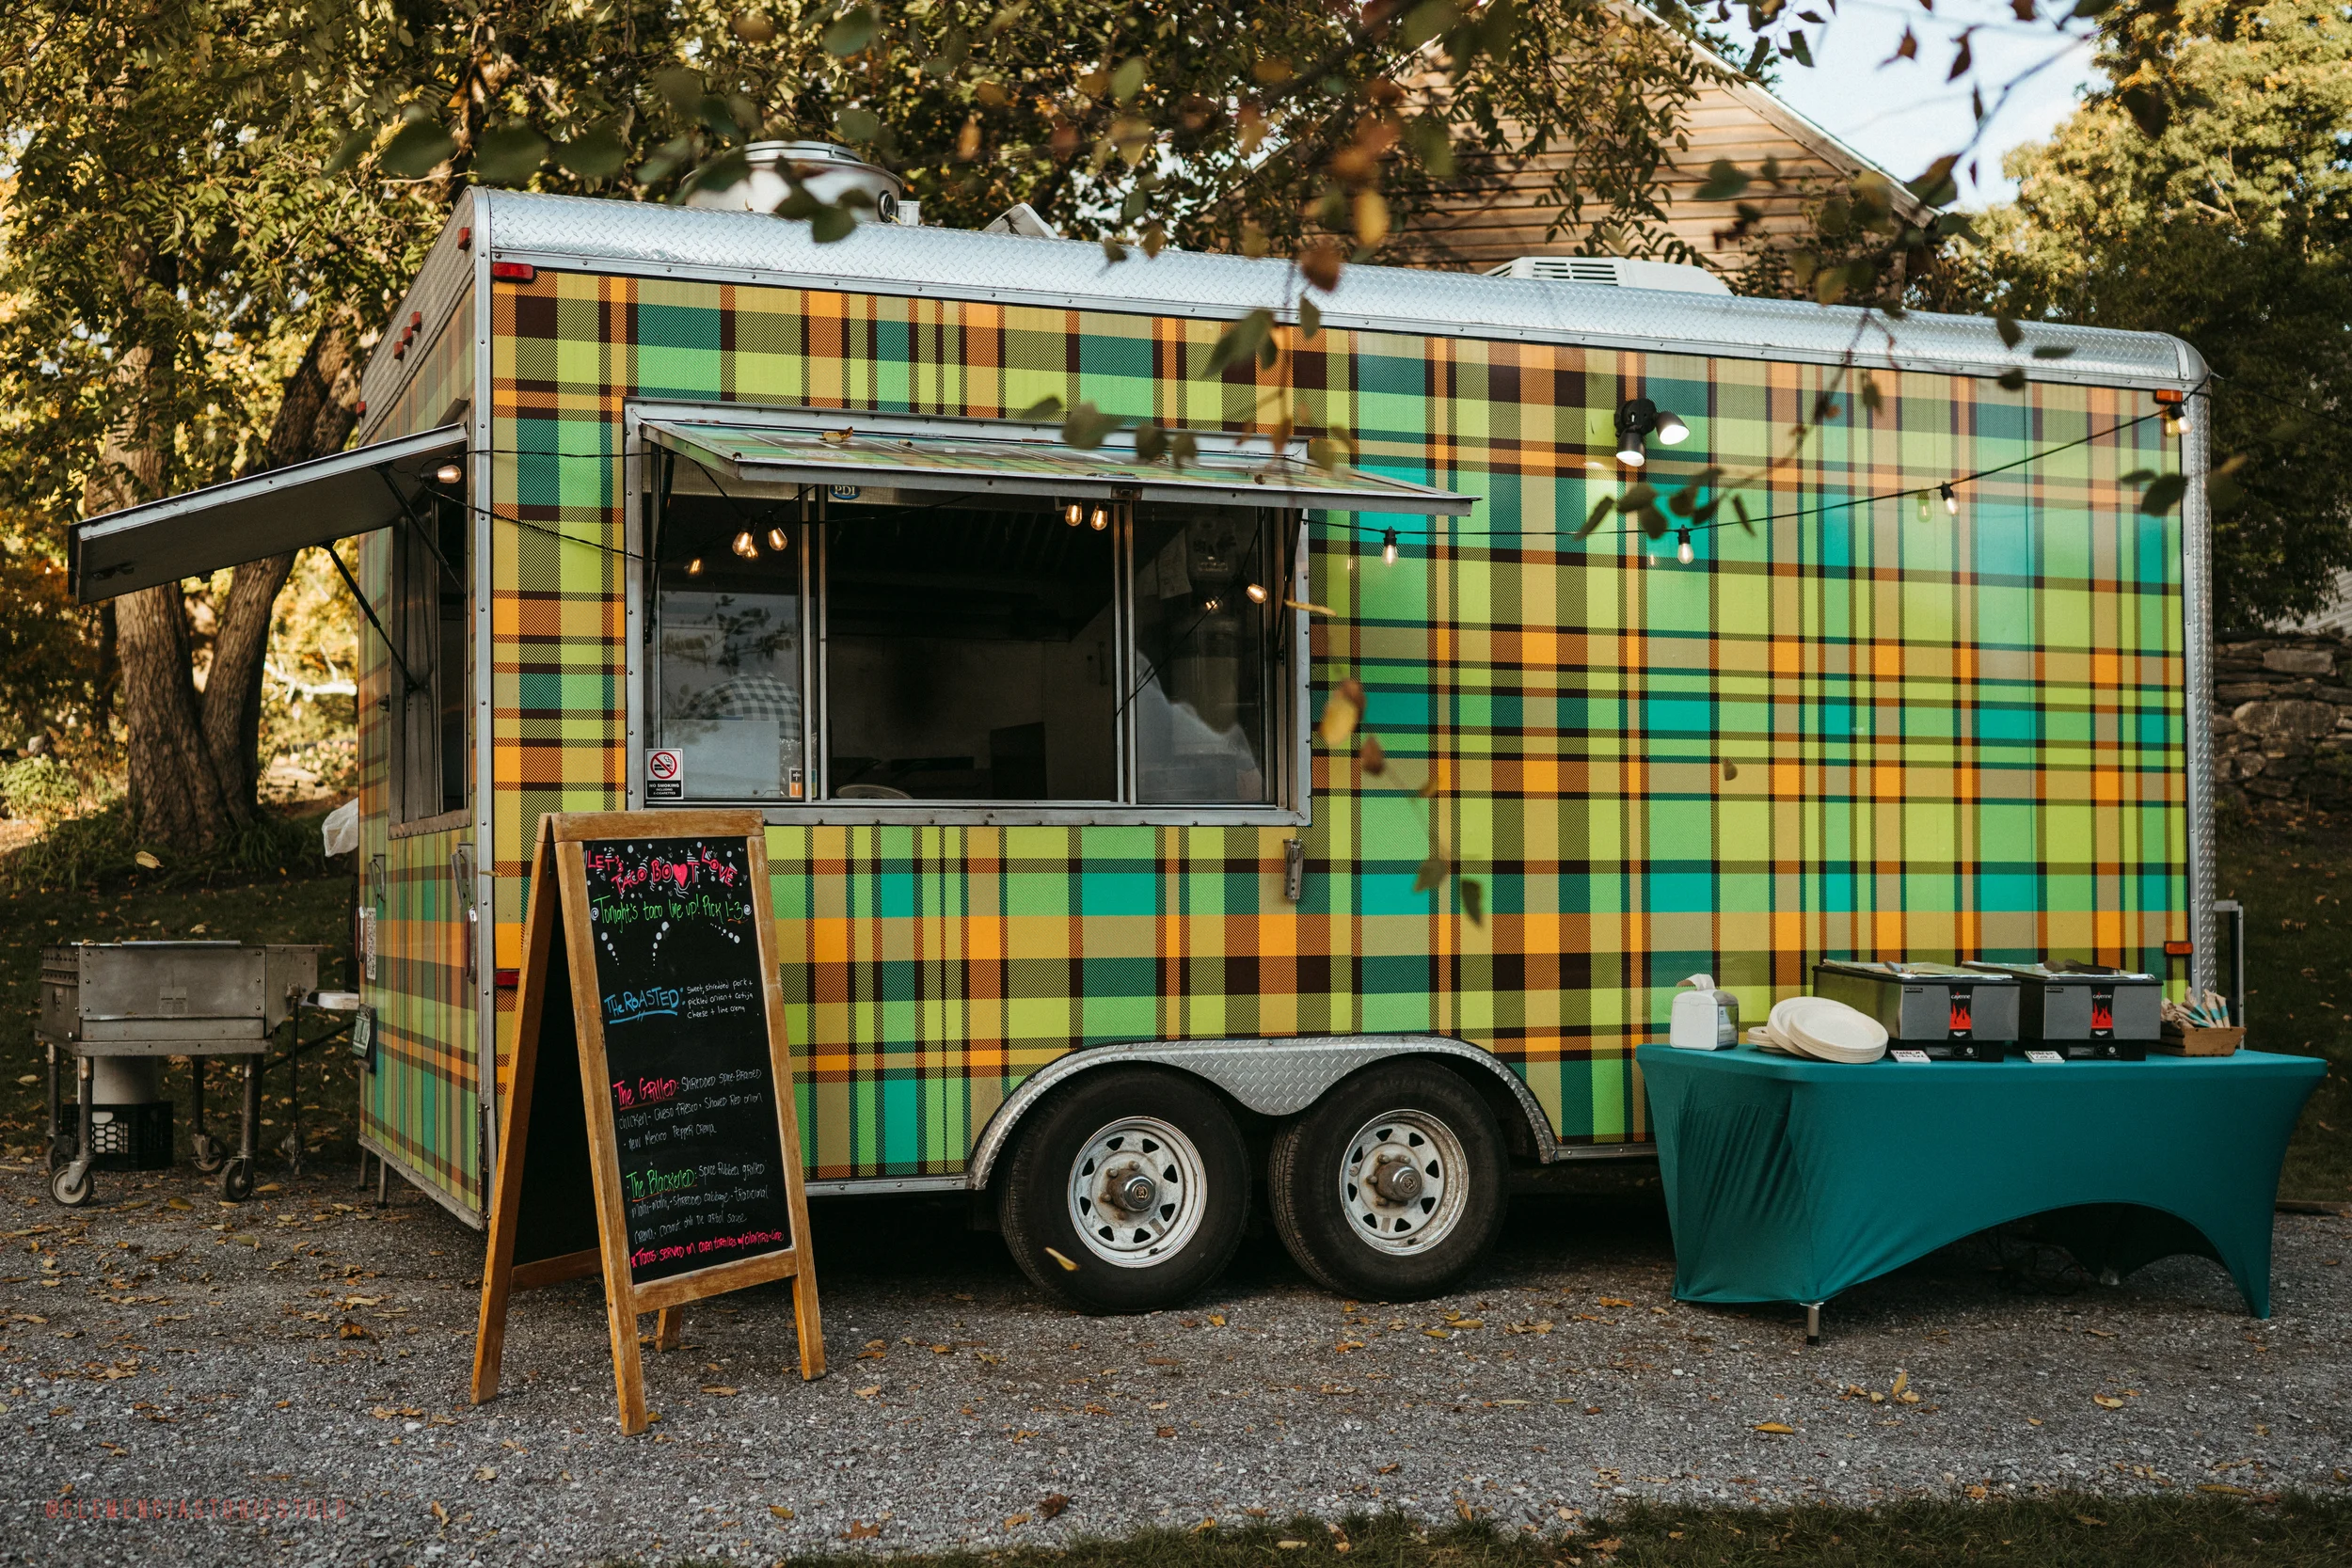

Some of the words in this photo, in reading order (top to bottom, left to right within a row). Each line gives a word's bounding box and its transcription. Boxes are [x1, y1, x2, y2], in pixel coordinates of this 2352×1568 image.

[834, 484, 856, 496] PDI
[701, 846, 738, 888] LOVE
[593, 895, 639, 933] Tonight's
[643, 900, 663, 922] taco
